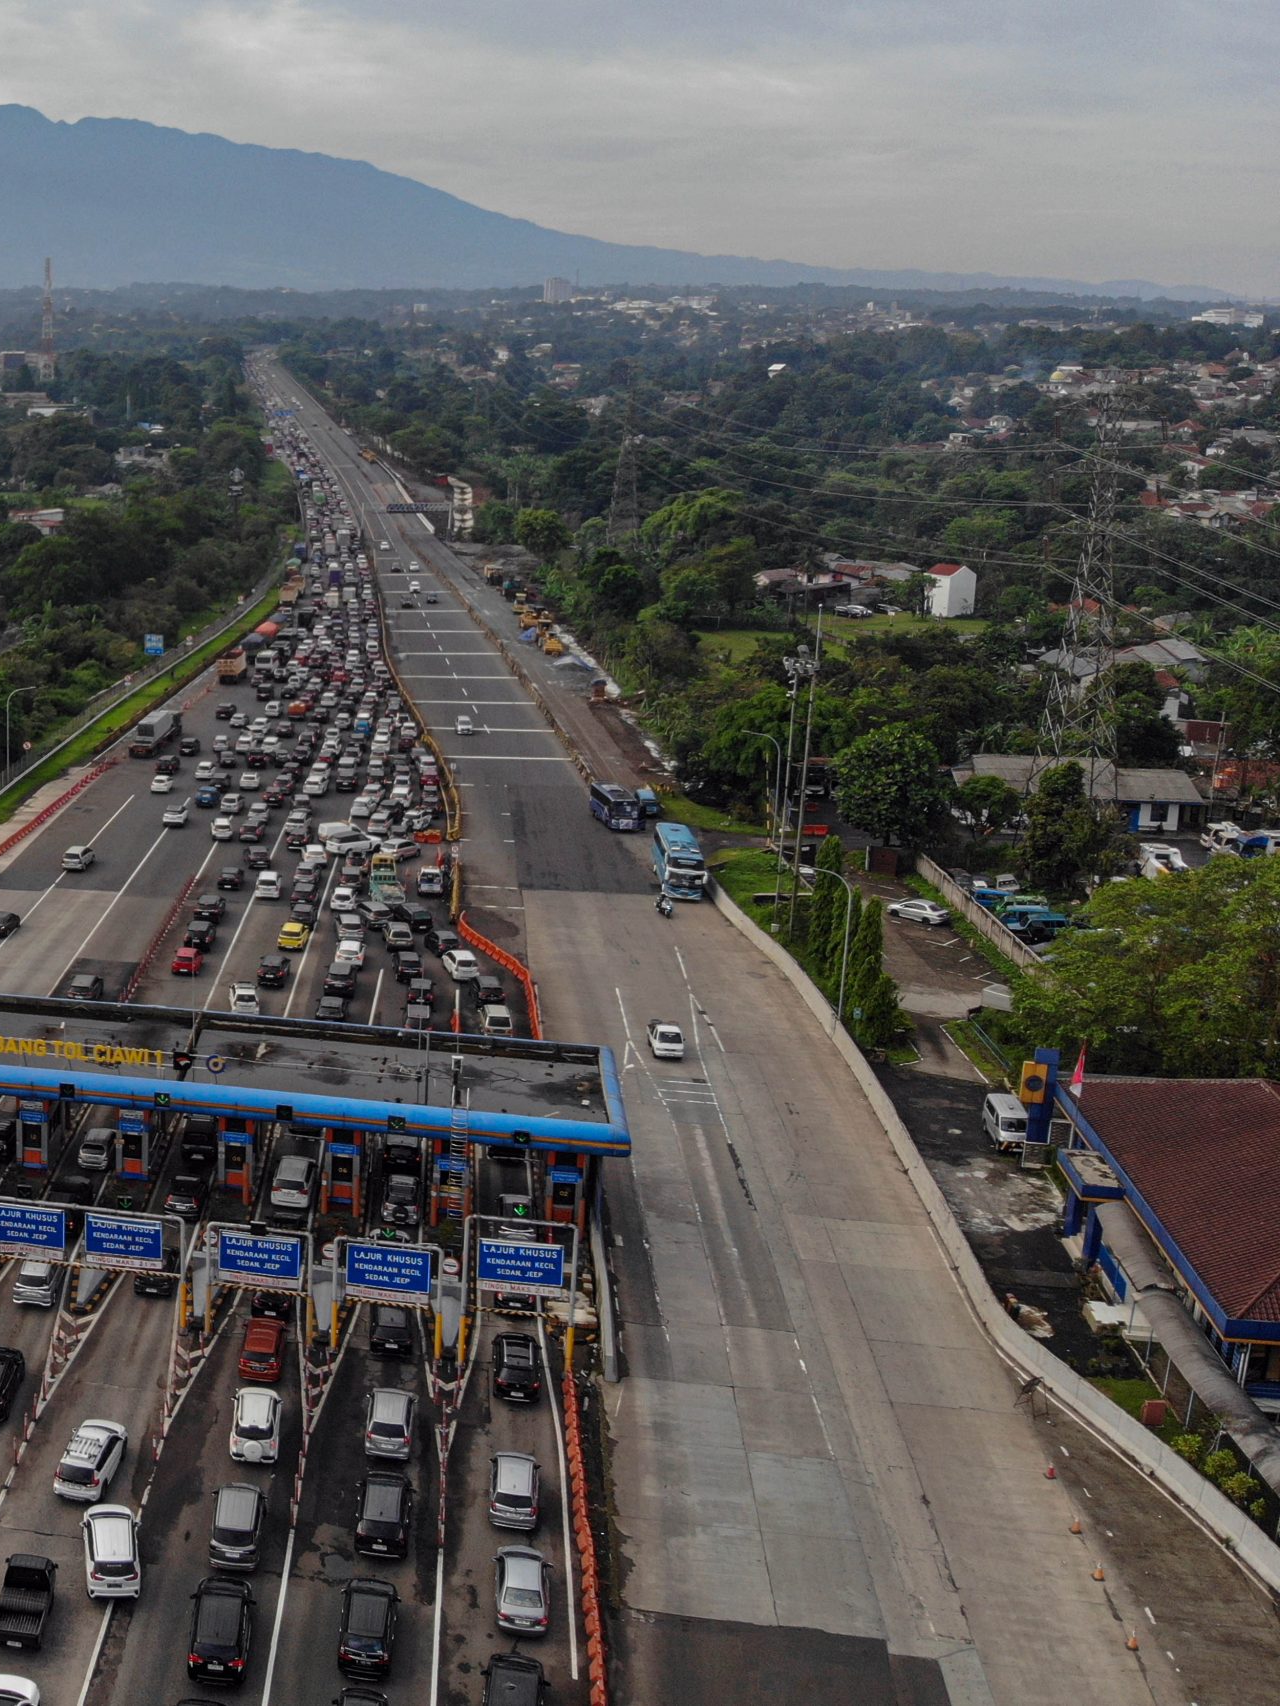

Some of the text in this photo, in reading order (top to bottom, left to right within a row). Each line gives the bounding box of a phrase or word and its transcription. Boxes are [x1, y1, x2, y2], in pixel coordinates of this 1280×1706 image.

[54, 1040, 88, 1061] TOL
[93, 1044, 149, 1066] CIAWI
[156, 1050, 163, 1067] 1
[26, 1212, 58, 1222] KHUSUS
[38, 1224, 57, 1233] KECIL
[92, 1220, 155, 1234] LAJUR KHUSUS
[93, 1231, 153, 1244] KENDARAAN KECIL
[226, 1236, 292, 1251] LAJUR KHUSUS
[226, 1249, 291, 1262] KENDARAAN KECIL
[354, 1251, 423, 1266] LAJUR KHUSUS
[483, 1245, 558, 1259] LAJUR KHUSUS
[486, 1257, 531, 1268] KENDARAAN
[355, 1263, 421, 1277] KENDARAAN KECIL
[392, 1276, 410, 1284] JEEP
